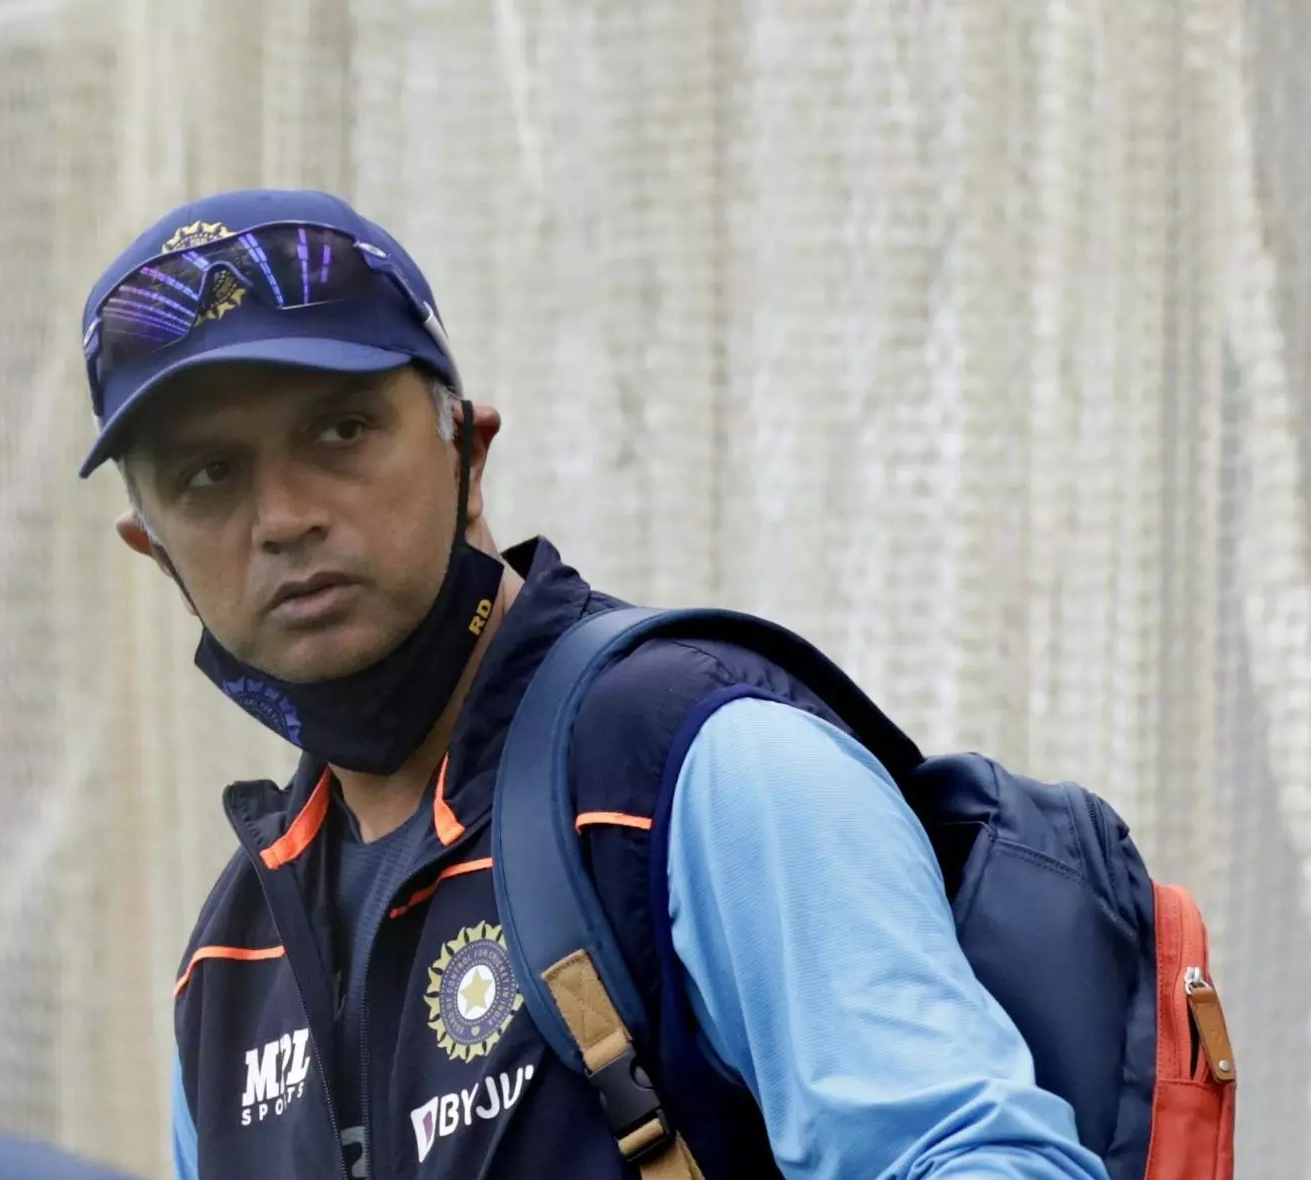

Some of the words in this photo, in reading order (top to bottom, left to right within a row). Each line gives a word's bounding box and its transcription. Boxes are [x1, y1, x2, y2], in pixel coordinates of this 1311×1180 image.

[468, 599, 492, 636] RD
[241, 1081, 304, 1126] SPOTS
[439, 1065, 534, 1137] BYJU'
